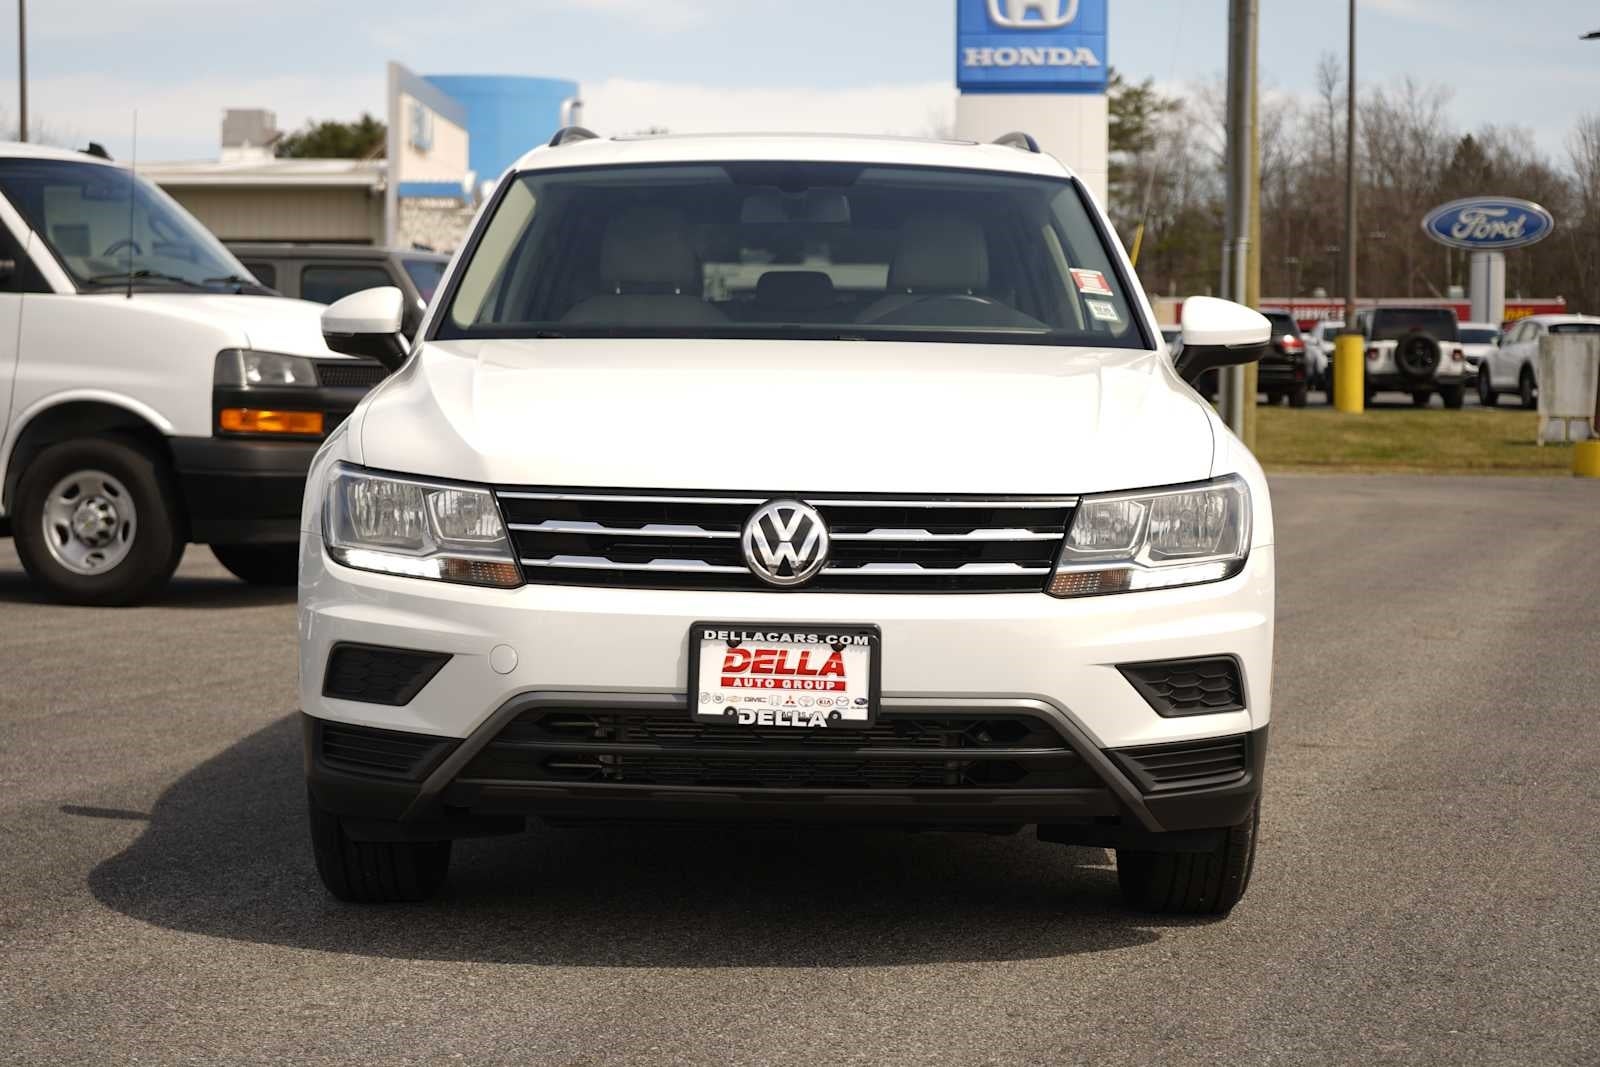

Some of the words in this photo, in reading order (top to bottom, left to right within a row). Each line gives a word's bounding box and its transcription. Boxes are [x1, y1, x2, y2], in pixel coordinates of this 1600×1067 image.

[964, 47, 1100, 66] HONDA
[1451, 207, 1527, 239] Ford
[704, 630, 868, 645] DELLACARS.COM
[722, 648, 845, 676] DELLA
[733, 678, 775, 688] AUTO
[782, 680, 836, 690] GROUP
[738, 708, 828, 727] DELLA
